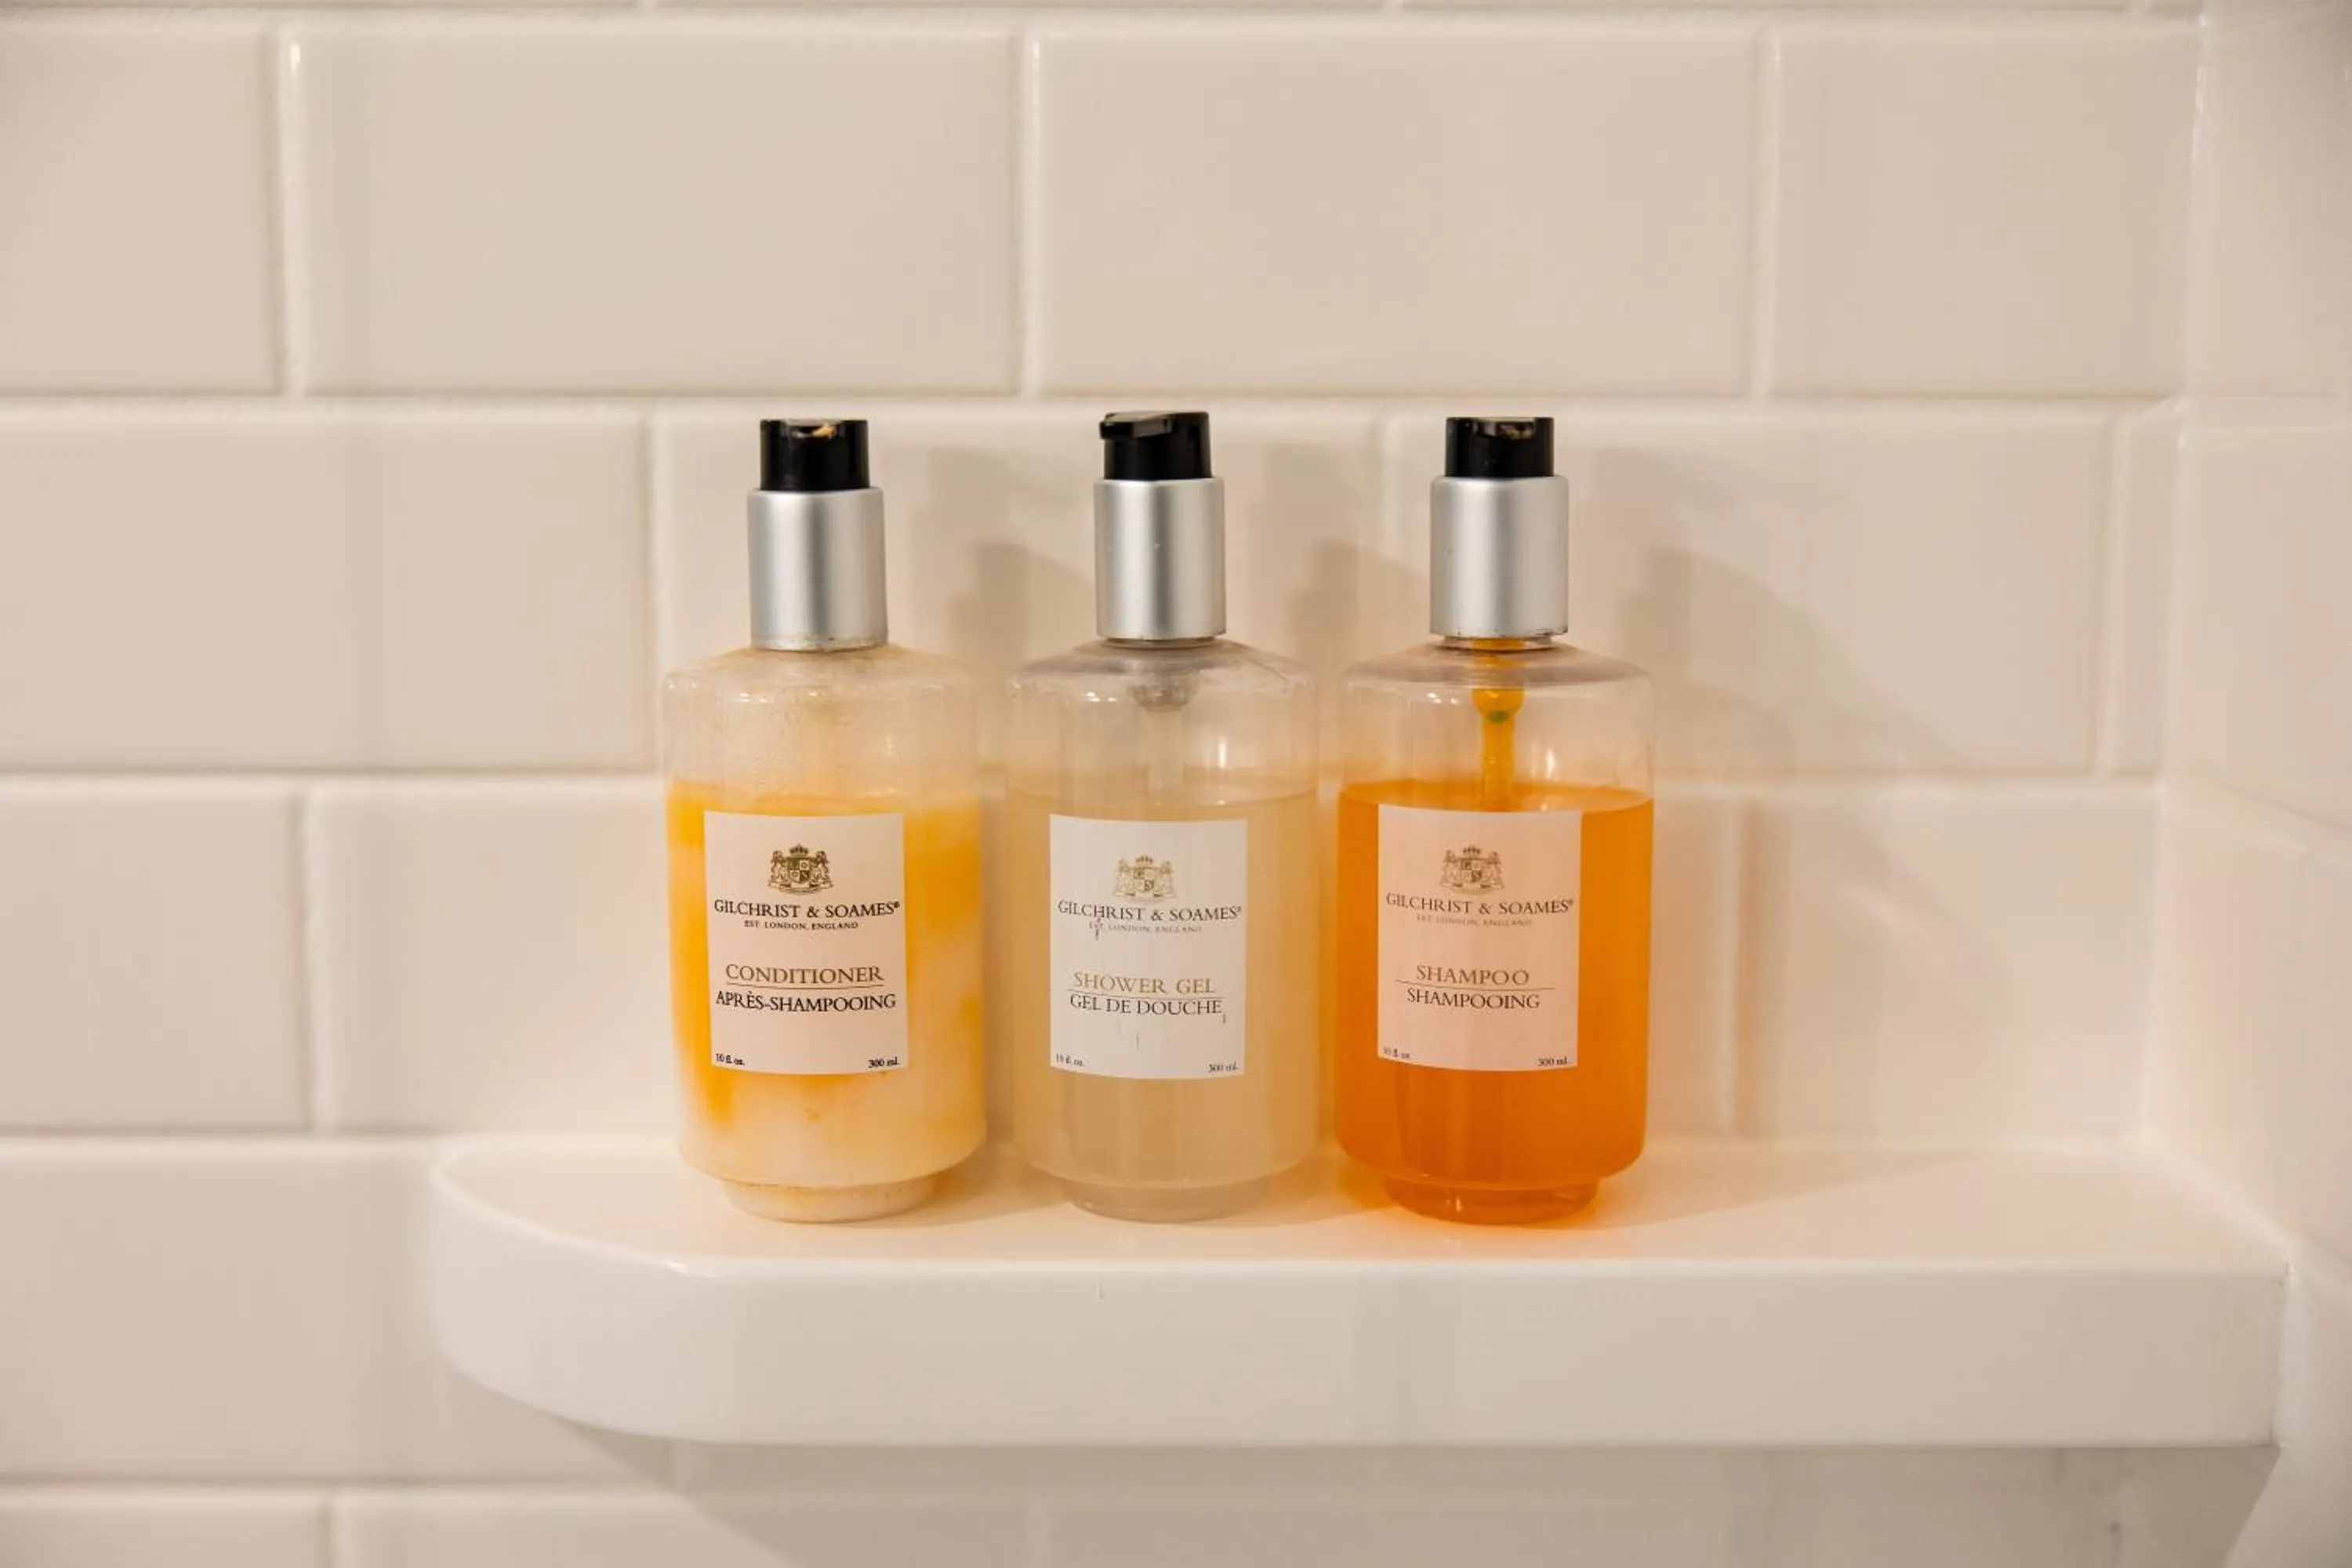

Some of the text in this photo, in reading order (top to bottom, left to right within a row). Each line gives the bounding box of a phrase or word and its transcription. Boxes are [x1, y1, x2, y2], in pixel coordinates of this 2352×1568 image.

[714, 899, 800, 918] GILCHRIST
[807, 906, 819, 919] &
[1058, 899, 1145, 921] GILCHRIST
[1151, 910, 1164, 921] &
[1386, 892, 1473, 914] GILCHRIST
[1479, 902, 1491, 915] &
[811, 921, 859, 931] ENGLAND
[725, 964, 885, 985] CONDITIONER
[1074, 971, 1216, 994] SHOWER GEL
[1416, 965, 1530, 985] SHAMPOO
[716, 989, 897, 1012] APRÈS-SHAMPOOING
[1070, 994, 1222, 1015] GEL DE DOUCHE
[1407, 987, 1540, 1009] SHAMPOOING
[868, 1058, 885, 1068] 300
